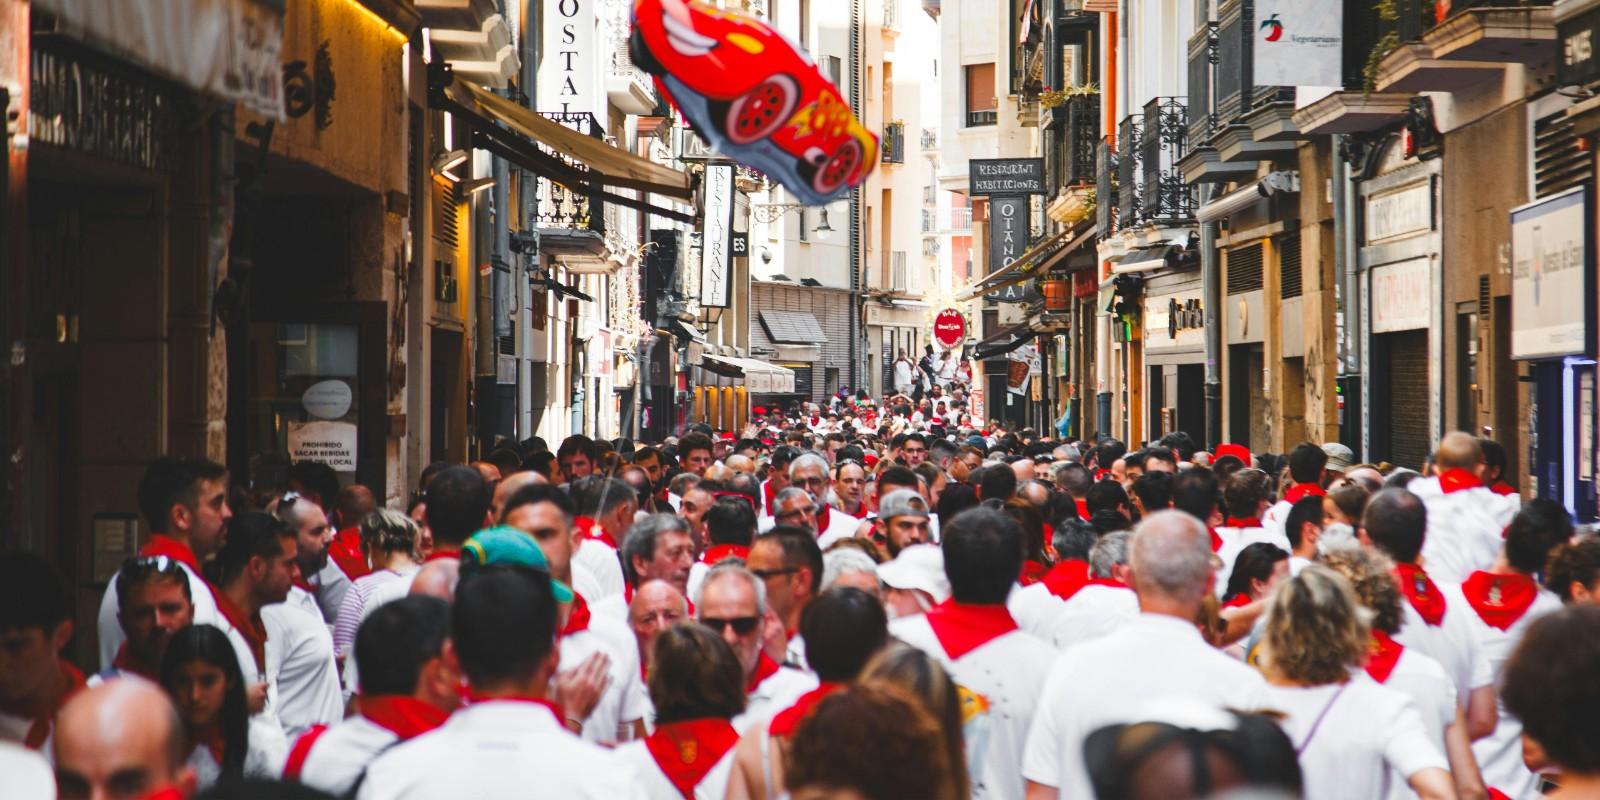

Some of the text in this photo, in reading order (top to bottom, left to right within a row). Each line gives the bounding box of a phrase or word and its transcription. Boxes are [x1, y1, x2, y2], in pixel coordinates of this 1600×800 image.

[979, 164, 1034, 175] RESTAURANT
[942, 309, 957, 318] BAR
[302, 441, 342, 449] PROHIBIDO
[294, 450, 318, 458] SACAR
